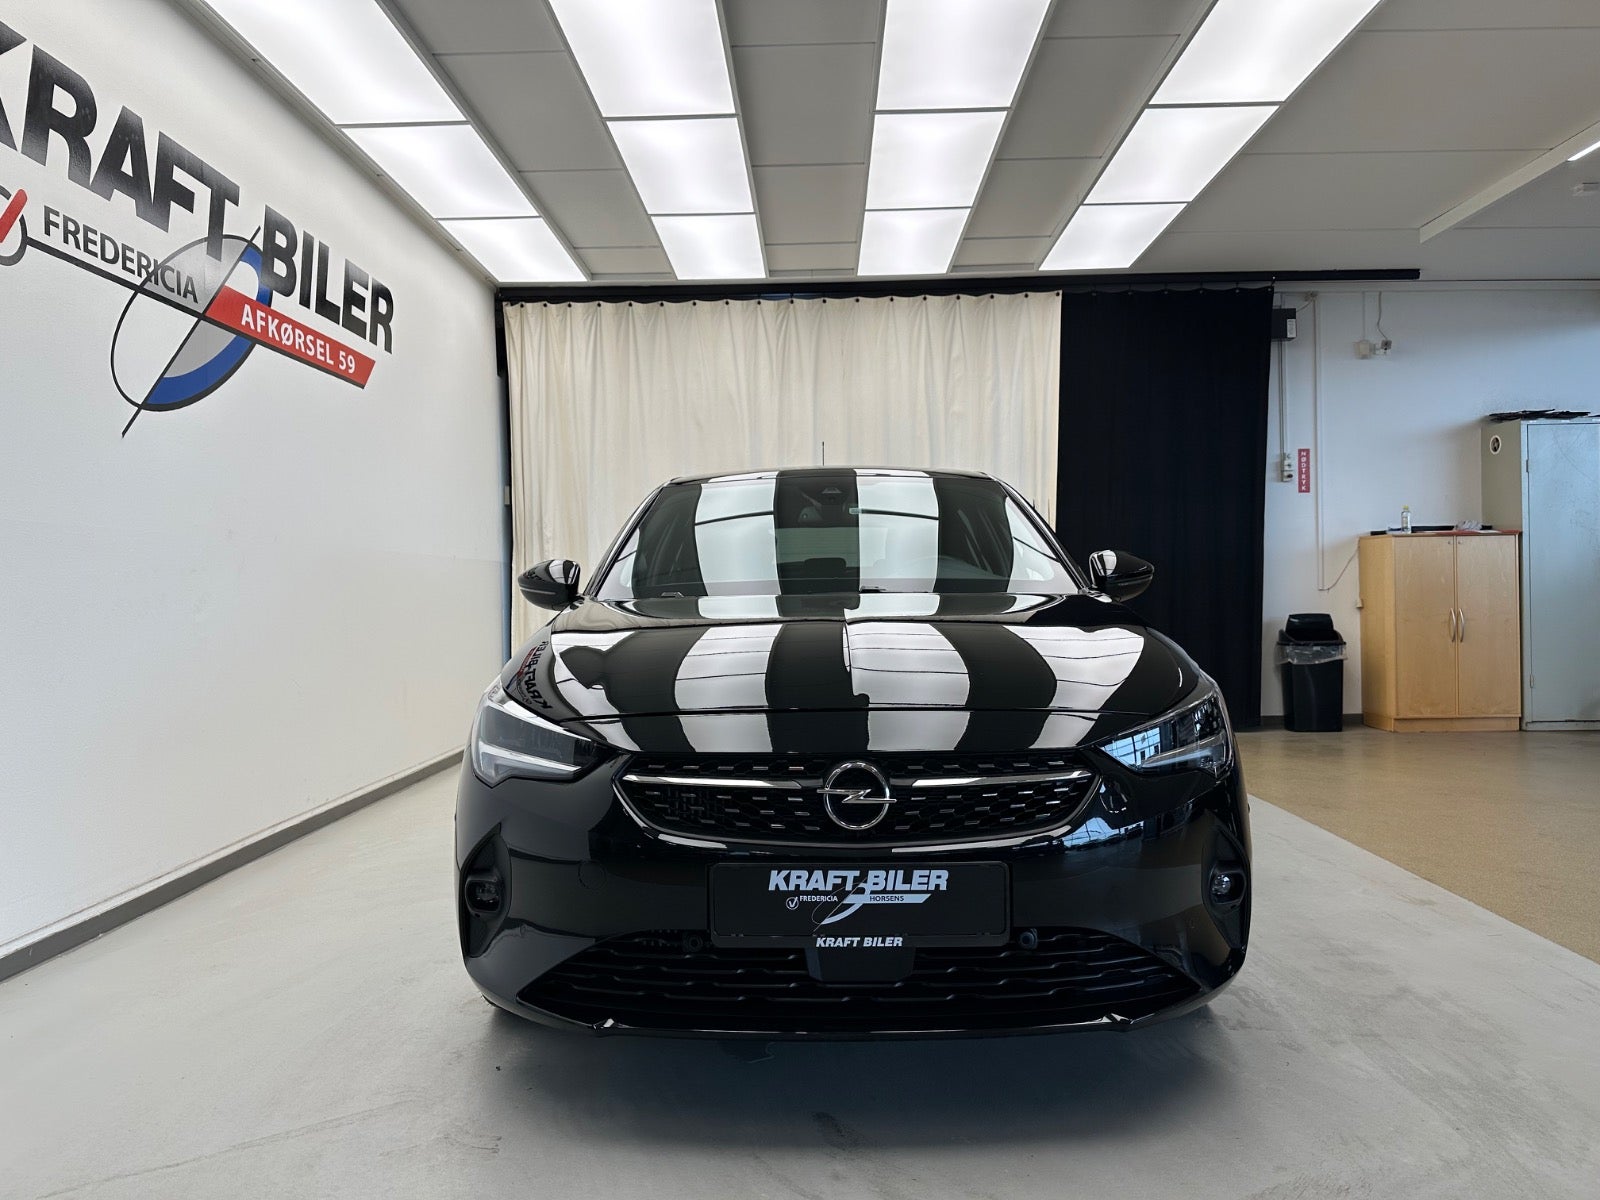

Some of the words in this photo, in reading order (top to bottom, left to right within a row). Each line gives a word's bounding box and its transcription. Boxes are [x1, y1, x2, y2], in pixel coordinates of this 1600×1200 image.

[43, 205, 199, 304] FREDERICIA
[261, 204, 394, 354] BILER
[241, 304, 334, 366] AFKØRSEL
[338, 352, 356, 374] 59
[768, 870, 860, 891] KRAFT
[867, 870, 949, 891] BILER
[815, 937, 861, 948] KRAFT
[863, 937, 903, 948] BILER
